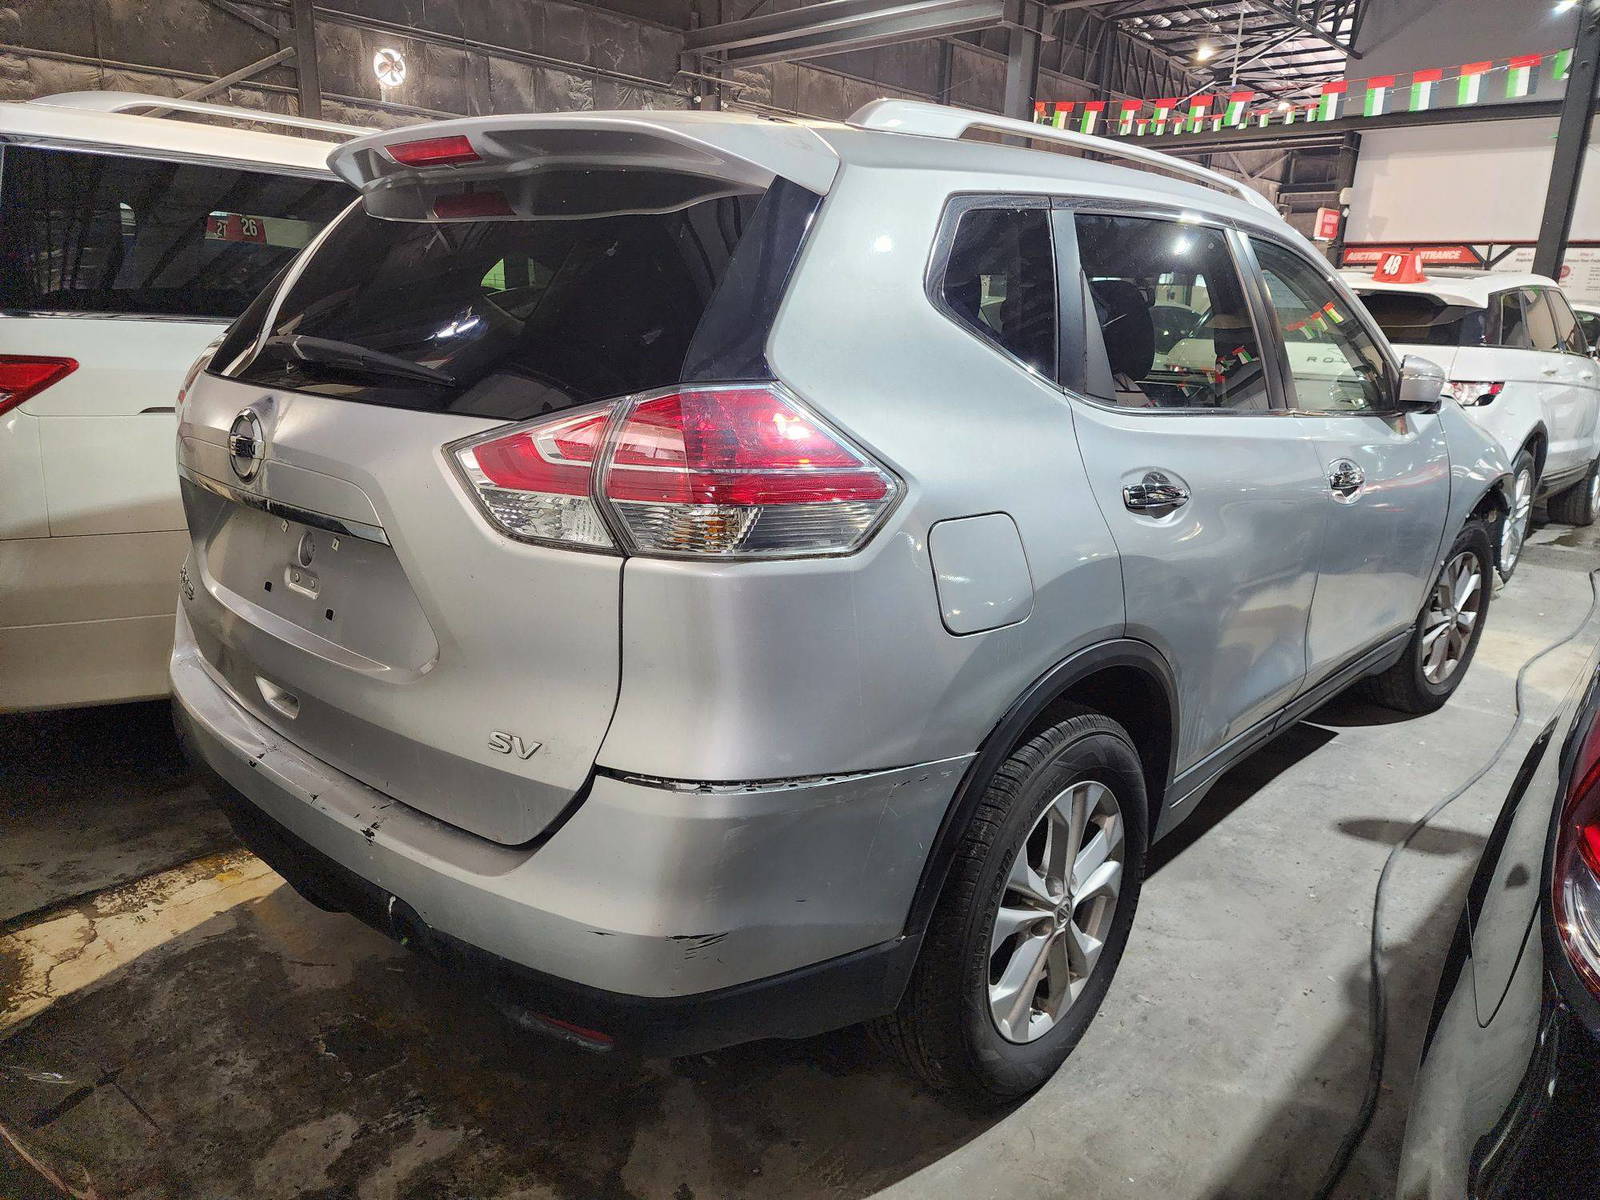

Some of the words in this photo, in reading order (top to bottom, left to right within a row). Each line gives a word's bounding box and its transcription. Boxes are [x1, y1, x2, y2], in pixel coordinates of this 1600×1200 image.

[241, 218, 258, 237] 26
[1383, 254, 1402, 275] 48
[487, 730, 543, 760] SV
